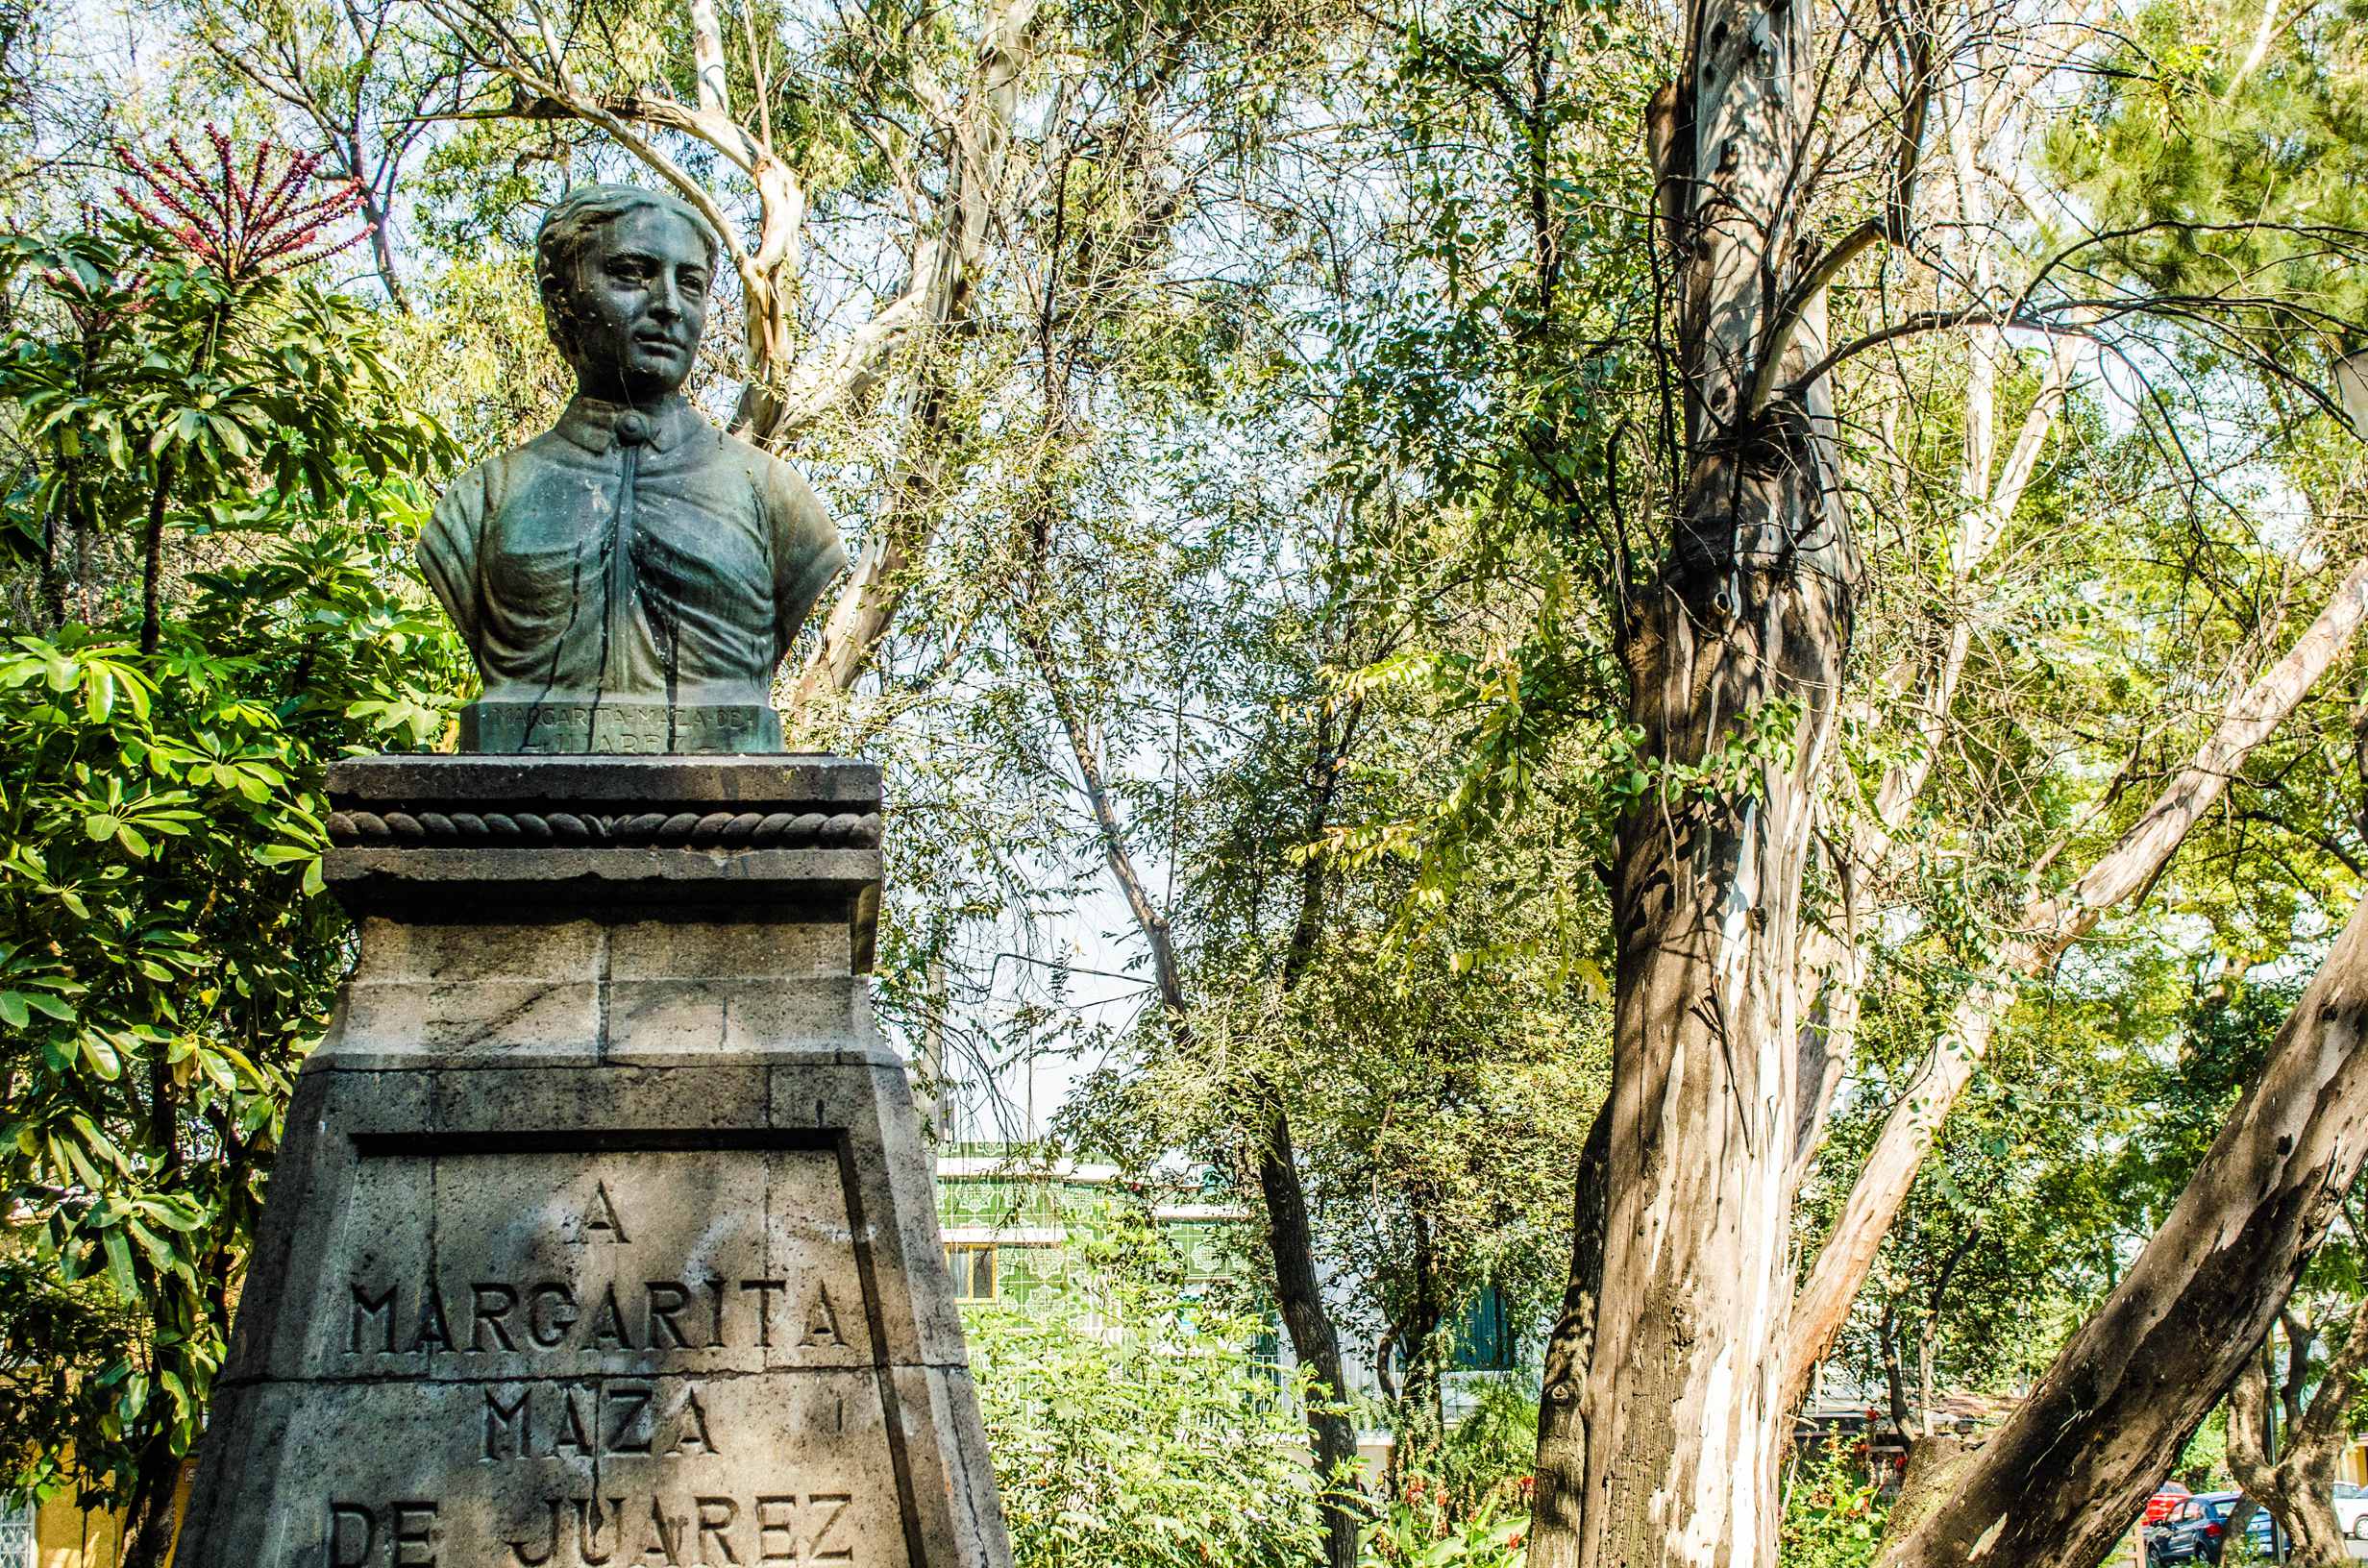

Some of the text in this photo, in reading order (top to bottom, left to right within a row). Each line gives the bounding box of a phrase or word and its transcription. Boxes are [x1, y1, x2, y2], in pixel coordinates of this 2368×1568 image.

[567, 1180, 632, 1244] A
[343, 1276, 849, 1355] MARGARITA
[478, 1384, 722, 1462] MAZA
[329, 1494, 854, 1568] DE JUAREZ
